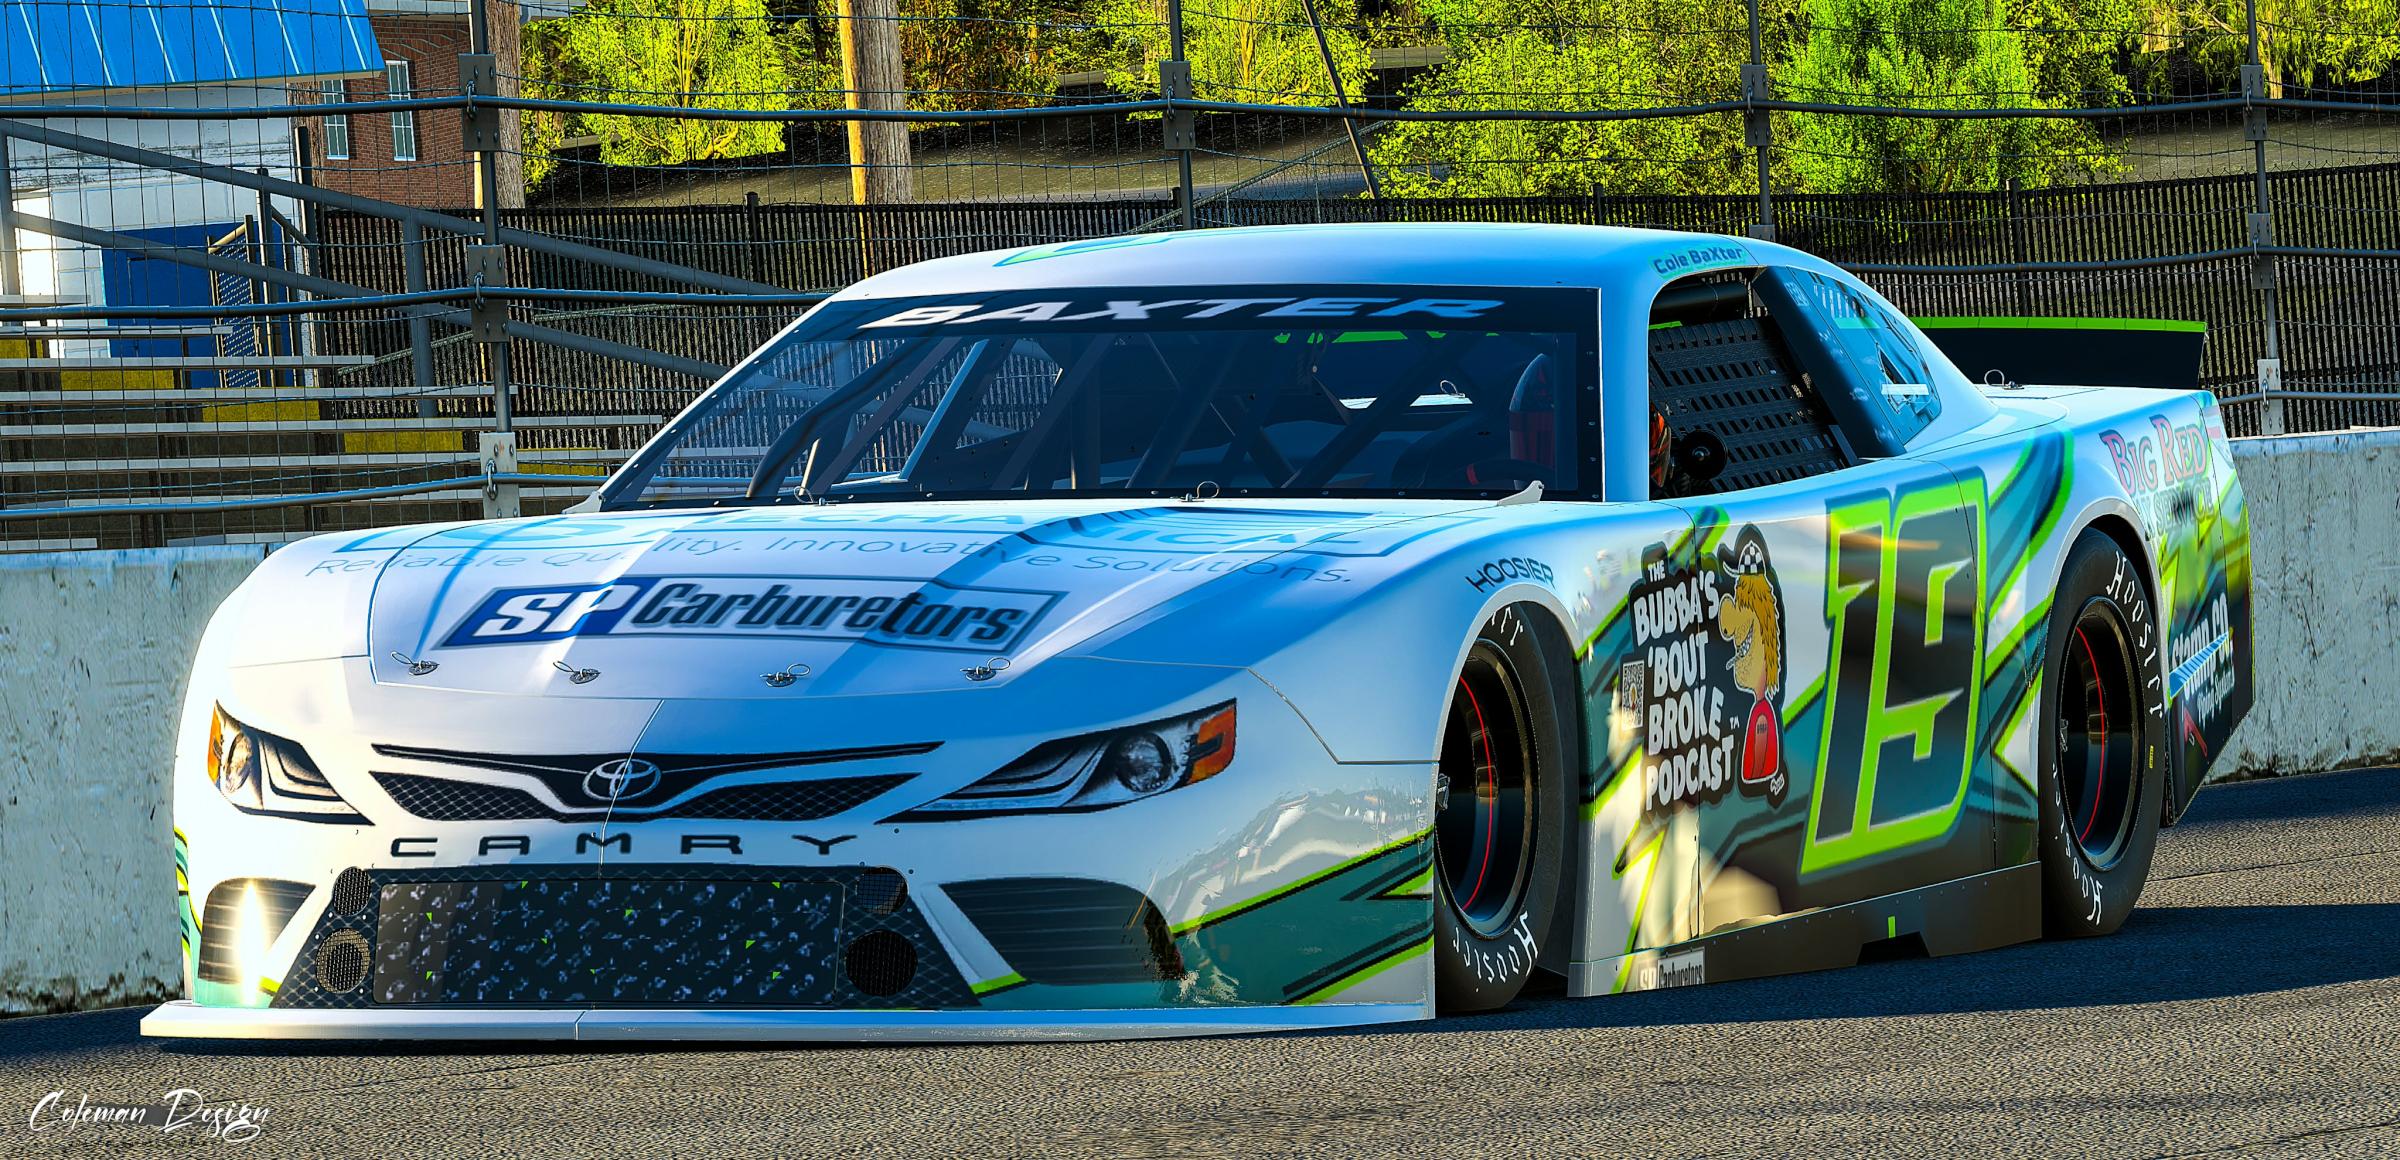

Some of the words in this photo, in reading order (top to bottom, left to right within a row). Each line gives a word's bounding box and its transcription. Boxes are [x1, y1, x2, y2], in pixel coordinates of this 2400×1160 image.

[1654, 253, 1689, 274] Cole
[857, 297, 1503, 328] BAXTER
[304, 551, 526, 577] Reliable
[543, 537, 742, 567] Qulity.
[765, 536, 1061, 567] Innovative
[1074, 553, 1351, 583] Solutions.
[1465, 557, 1556, 593] HOOSIER
[1647, 559, 1666, 583] THE
[471, 583, 638, 638] SP
[632, 583, 1021, 642] Carburetors
[1633, 570, 1718, 647] BUBBA'S
[1648, 631, 1708, 698] 'BOUT
[1800, 474, 1986, 876] 19
[1649, 684, 1724, 756] BROKE
[1645, 734, 1734, 811] PODCAST
[390, 833, 858, 857] CAMRY
